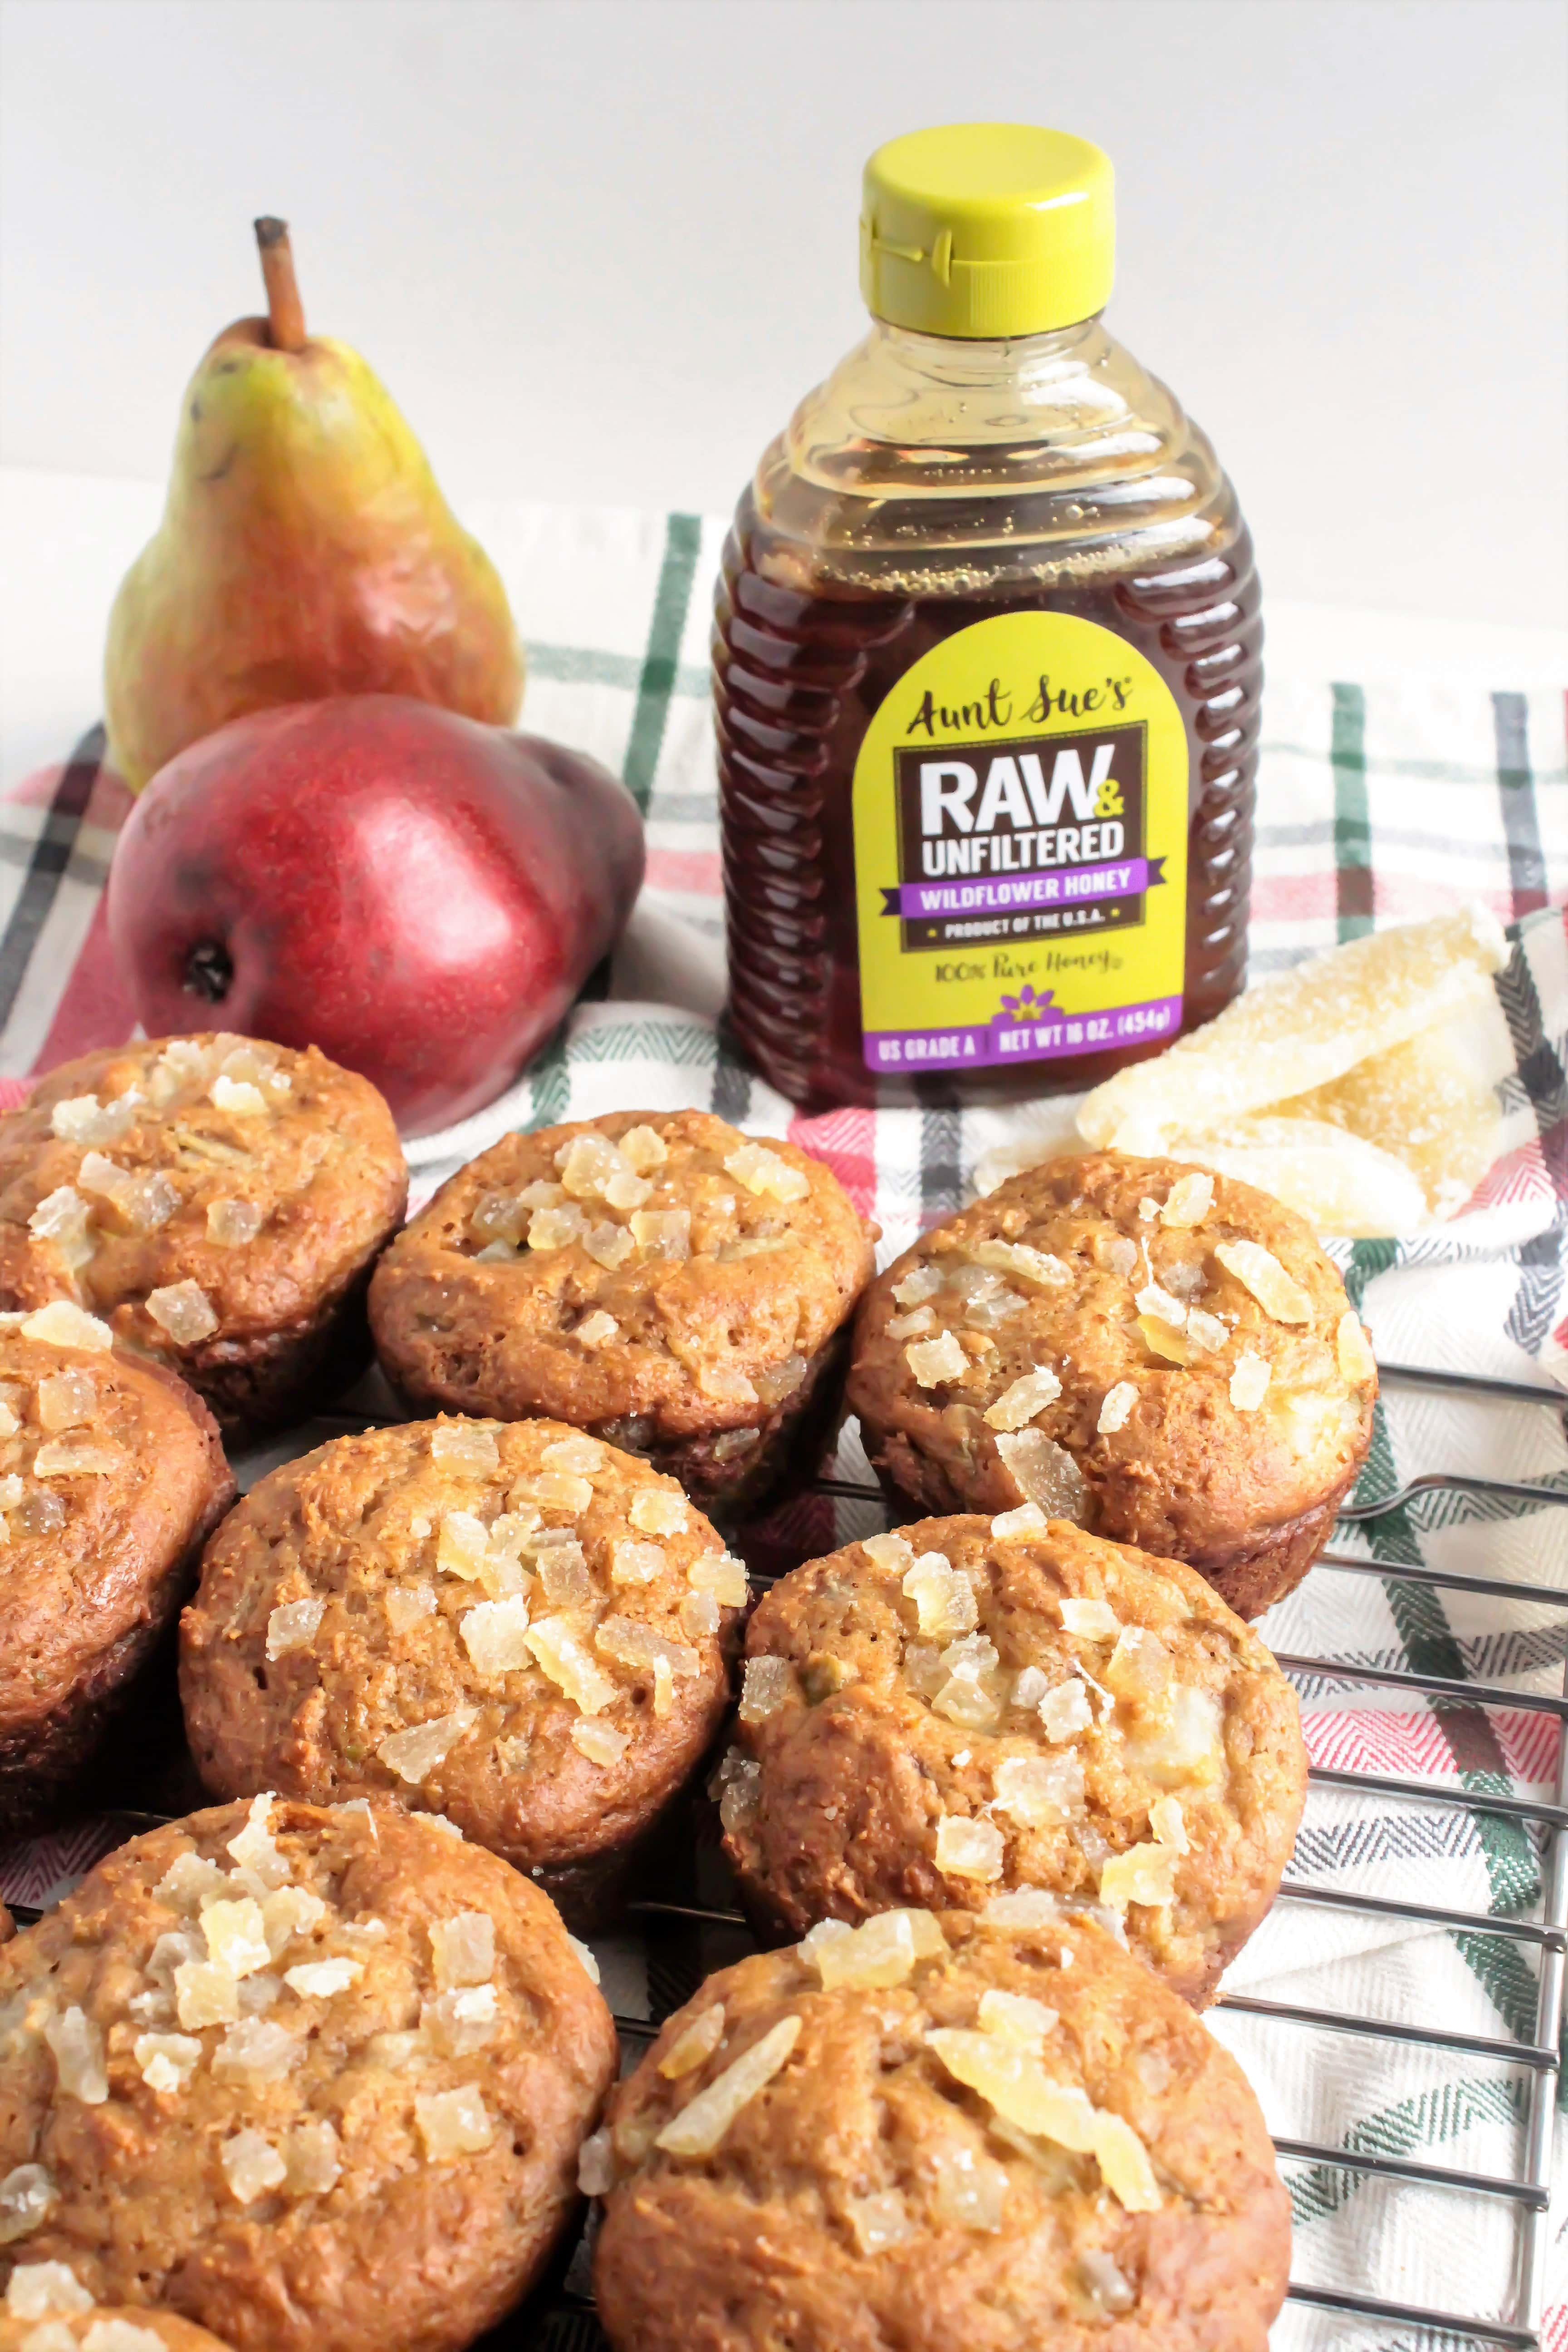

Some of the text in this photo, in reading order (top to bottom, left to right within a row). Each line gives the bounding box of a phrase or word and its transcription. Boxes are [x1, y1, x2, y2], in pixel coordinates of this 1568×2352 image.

[905, 674, 1133, 736] Aunt Sue's
[920, 744, 1125, 836] RAW &
[921, 820, 1125, 877] UNFILTERED
[920, 867, 1132, 911] WILDFLOWER HONEY
[945, 919, 1009, 939] PRODUCT
[1012, 916, 1029, 933] OF
[1034, 913, 1060, 930] THE
[936, 961, 986, 983] 100%
[992, 952, 1036, 978] Pure
[878, 1034, 975, 1062] US GRADE A
[999, 1028, 1030, 1053] NET
[1034, 1024, 1062, 1049] WT
